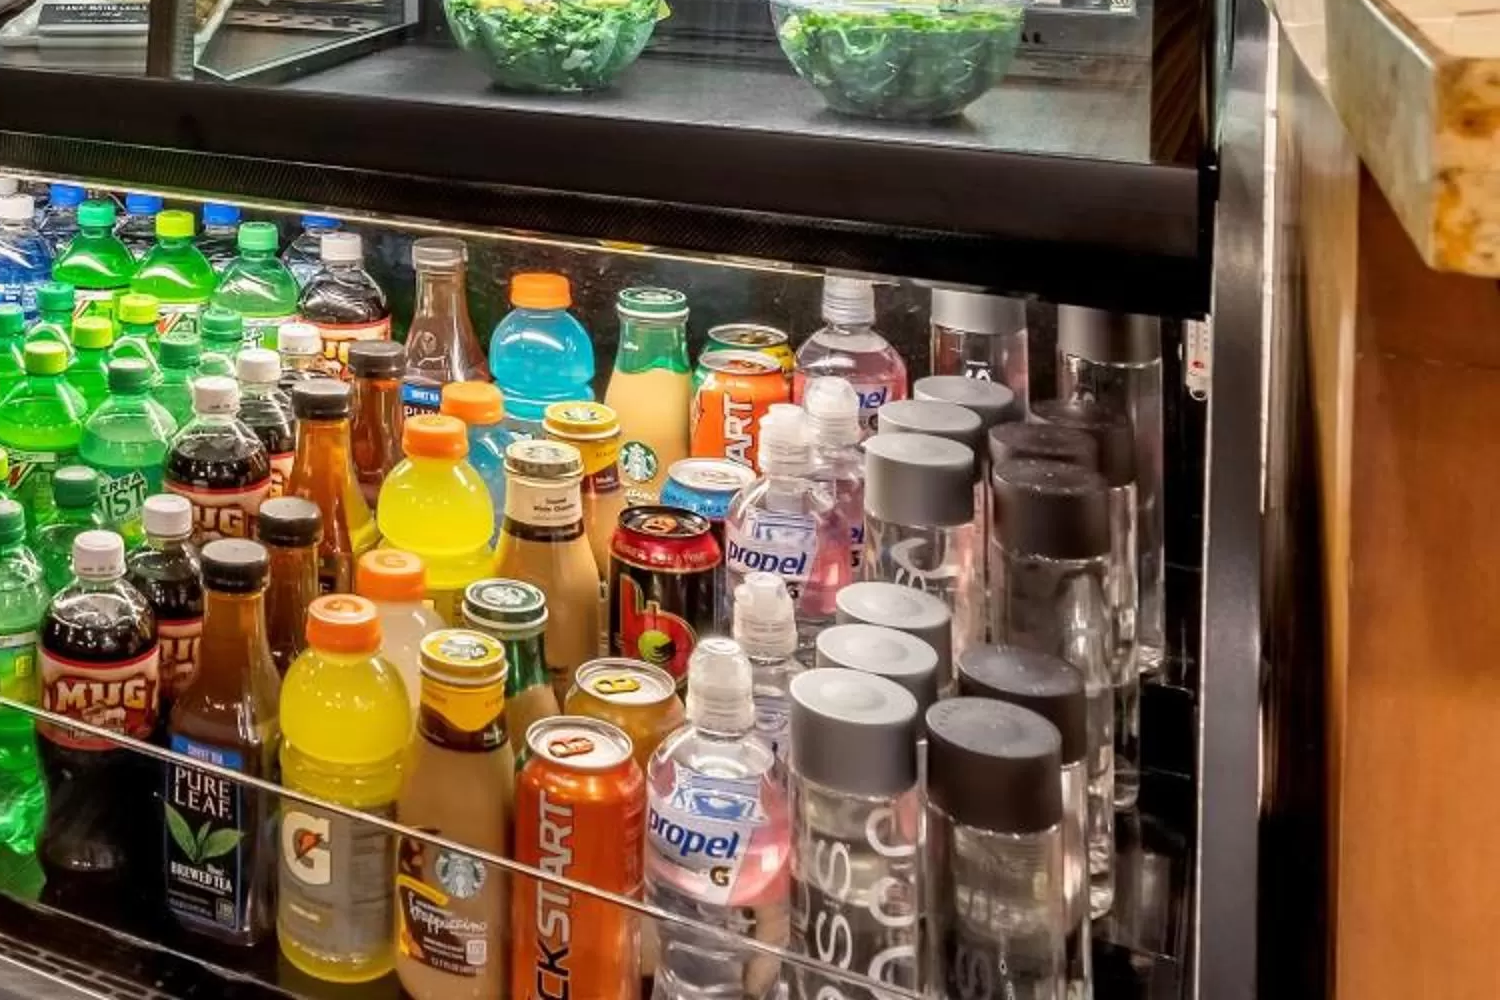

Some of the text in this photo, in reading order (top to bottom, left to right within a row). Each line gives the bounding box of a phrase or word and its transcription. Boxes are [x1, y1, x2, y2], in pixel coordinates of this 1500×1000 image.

[100, 471, 142, 494] ERRA
[102, 480, 146, 520] IST
[192, 506, 247, 538] UG
[728, 540, 807, 576] propel
[55, 679, 149, 712] MUG
[174, 765, 232, 801] PURE
[174, 783, 233, 820] LEAF
[282, 810, 331, 885] G
[649, 807, 740, 859] propel
